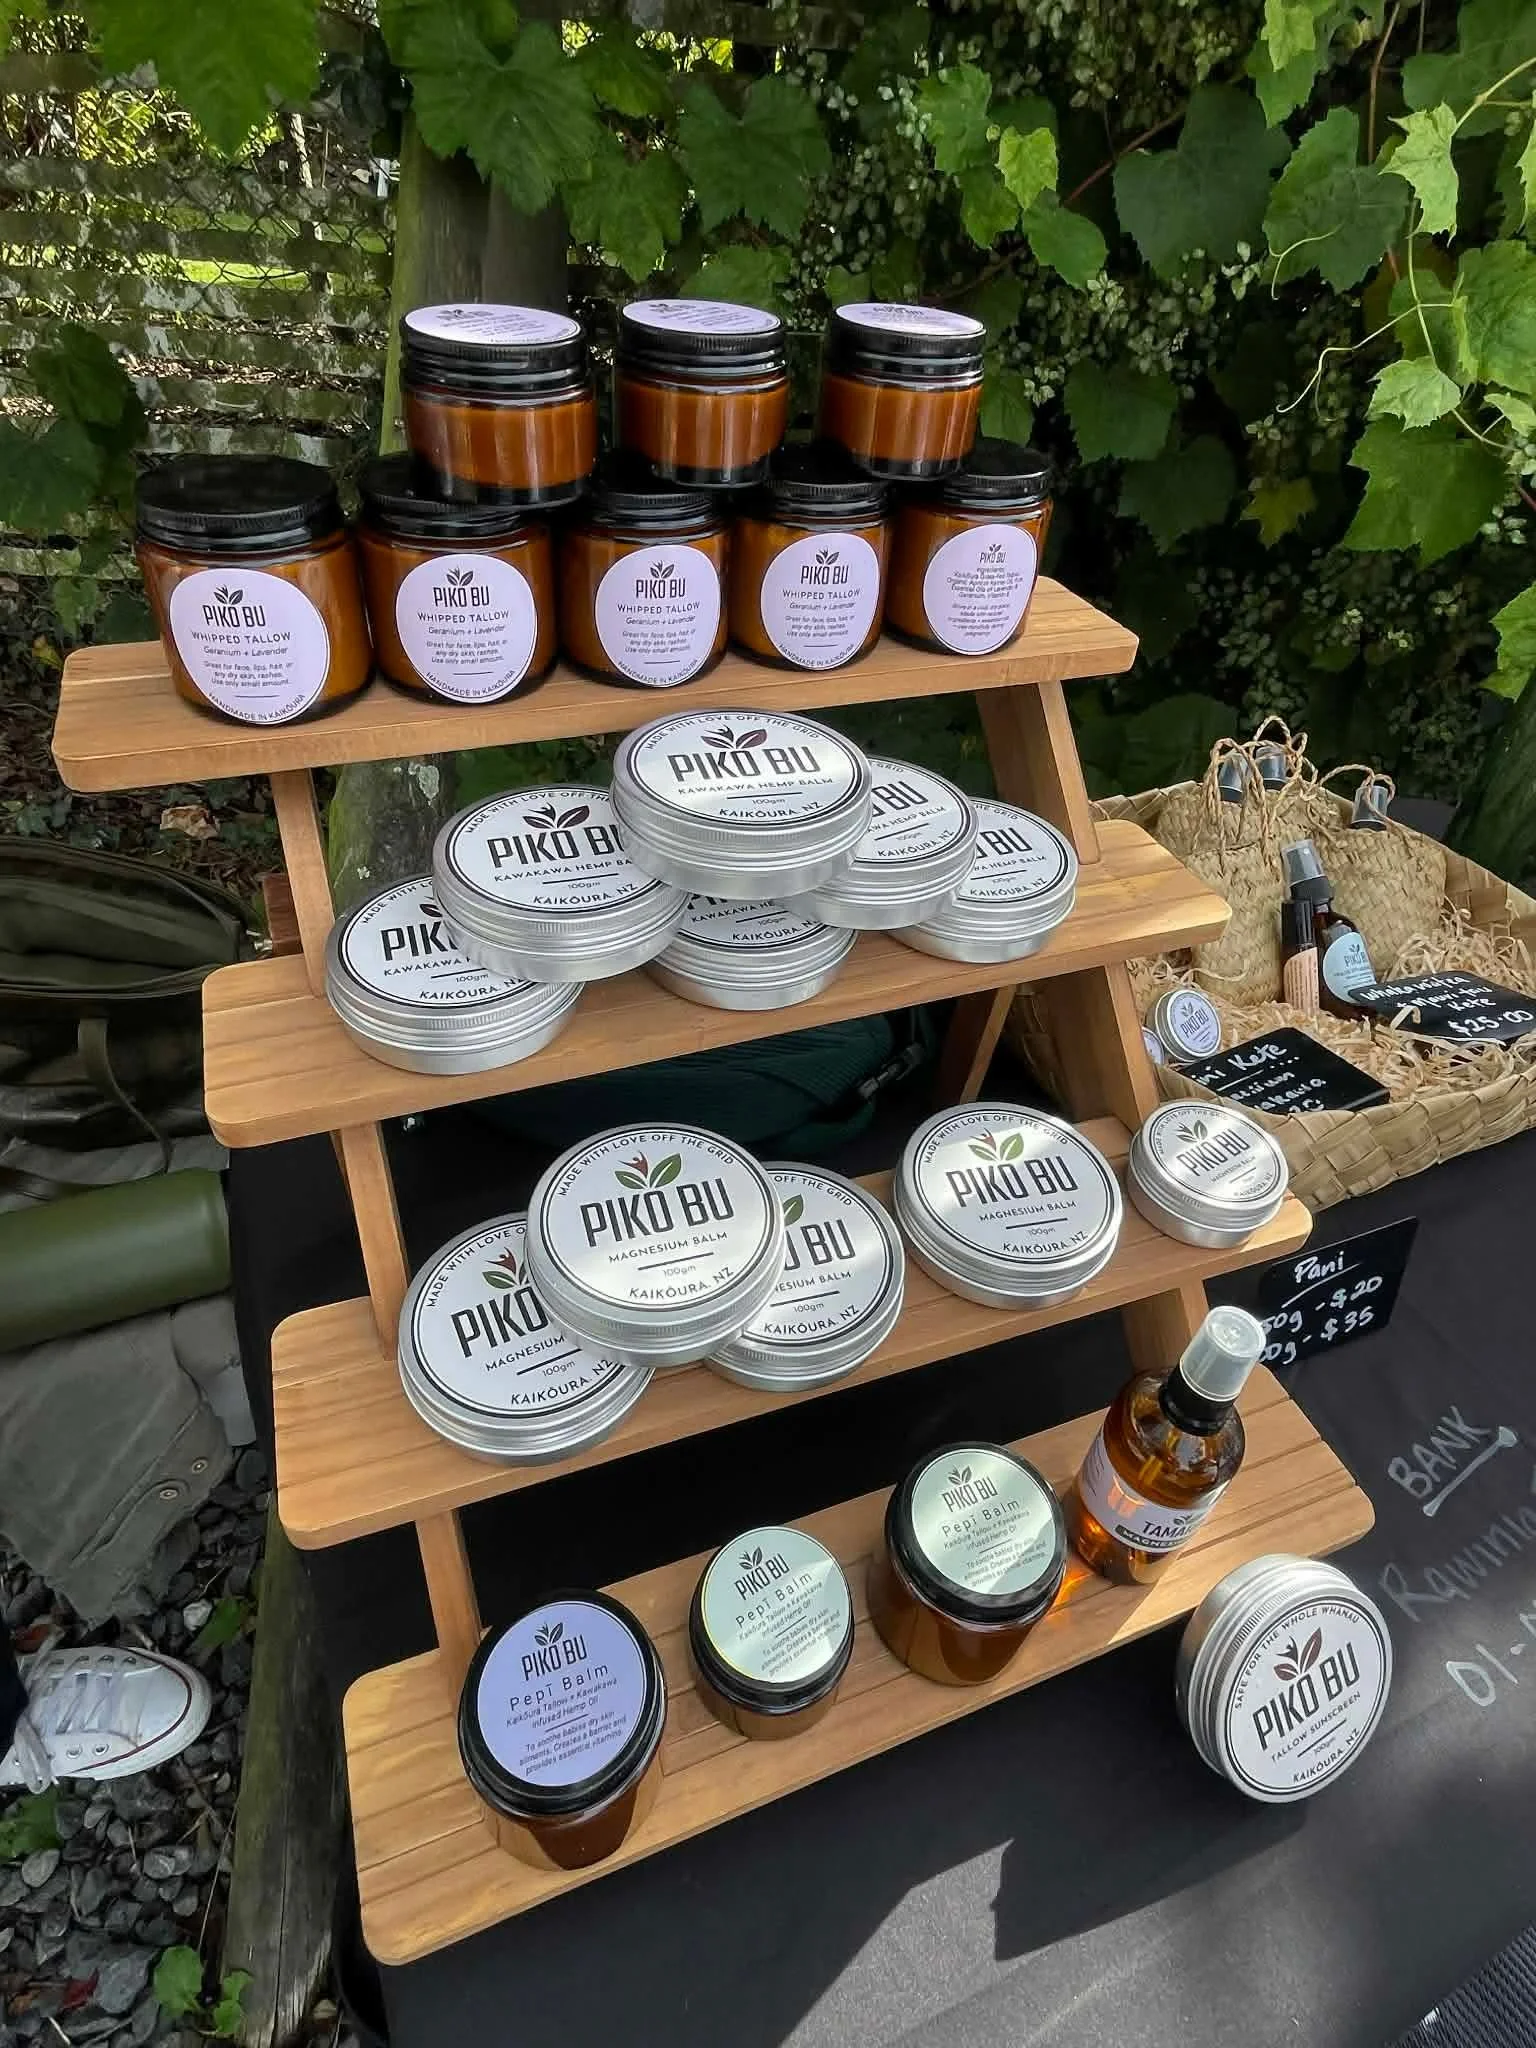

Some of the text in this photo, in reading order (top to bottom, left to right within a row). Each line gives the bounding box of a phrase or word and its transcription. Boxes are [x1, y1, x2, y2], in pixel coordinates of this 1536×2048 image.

[980, 552, 1006, 564] PIKO BU
[800, 564, 849, 585] PIKO BU
[433, 586, 490, 608] PIKO BU
[636, 578, 686, 599] PIKO BU
[782, 588, 860, 600] WHIPPED TALLOW
[202, 604, 266, 628] PIKO BU
[418, 610, 510, 624] WHIPPED TALLOW
[617, 601, 700, 614] WHIPPED TALLOW
[191, 631, 291, 644] WHIPPED TALLOW
[428, 625, 506, 636] Geranium Lavender
[203, 646, 288, 656] Geranium Lavender
[208, 692, 256, 720] HANDMADE
[646, 714, 822, 750] MADE WITH LOVE OFF THE GRID
[667, 746, 822, 782] PIKO BU
[678, 777, 834, 796] KAWAKAWA HEMP BALM
[871, 780, 929, 810] BU
[465, 791, 586, 834] MADE WITH LOVE OFF
[802, 800, 824, 814] NZ
[889, 806, 946, 825] HEMP BALM
[938, 830, 954, 840] NZ
[980, 827, 1032, 856] BU
[486, 829, 580, 869] PIKO
[494, 861, 612, 882] KAWAKAWA HEMP
[1031, 878, 1048, 888] NZ
[616, 883, 640, 896] NZ
[690, 904, 757, 923] KAWAKAWA
[380, 921, 457, 962] PIK
[383, 958, 465, 977] KAWAKAWA
[1181, 1016, 1201, 1039] PIKO
[1195, 1008, 1209, 1026] BU
[1227, 1044, 1288, 1071] Kete
[557, 1133, 735, 1196] MADE WITH LOVE OFF THE GRID
[1176, 1140, 1229, 1177] PIKO
[1214, 1128, 1250, 1156] BU
[945, 1155, 1079, 1208] PIKO BU
[580, 1178, 734, 1248] PIKO BU
[978, 1200, 1077, 1222] MAGNESIUM BALM
[608, 1231, 728, 1264] MAGNESIUM BALM
[800, 1218, 856, 1266] BU
[1072, 1230, 1089, 1244] NZ
[426, 1229, 512, 1308] MADE WITH LOVE
[712, 1266, 735, 1284] NZ
[818, 1270, 852, 1284] BALM
[1294, 1250, 1344, 1284] Pani
[450, 1286, 550, 1358] PIKO
[839, 1304, 860, 1321] NZ
[485, 1334, 566, 1372] MAGNESIUM
[542, 1360, 576, 1377] 100gm
[592, 1358, 614, 1376] NZ
[1387, 1405, 1491, 1498] BANK
[941, 1476, 998, 1513] PIKO BU
[982, 1500, 1020, 1522] Balm
[734, 1552, 790, 1600] PIKO BU
[774, 1572, 813, 1602] Balm
[521, 1634, 588, 1682] PIKO BU
[1234, 1678, 1250, 1710] SAFE
[1247, 1652, 1262, 1676] FOR
[1260, 1630, 1281, 1650] THE
[1281, 1608, 1318, 1630] WHOLE
[562, 1664, 610, 1692] Balm
[543, 1696, 568, 1712] Tallow
[576, 1677, 618, 1698] Kawakawa
[1252, 1642, 1360, 1750] PIKO BU
[532, 1710, 562, 1730] infused
[562, 1702, 588, 1719] Hemp
[612, 1714, 627, 1729] and
[1270, 1690, 1362, 1764] TALLOW SUNSCREEN
[1346, 1727, 1360, 1746] NZ
